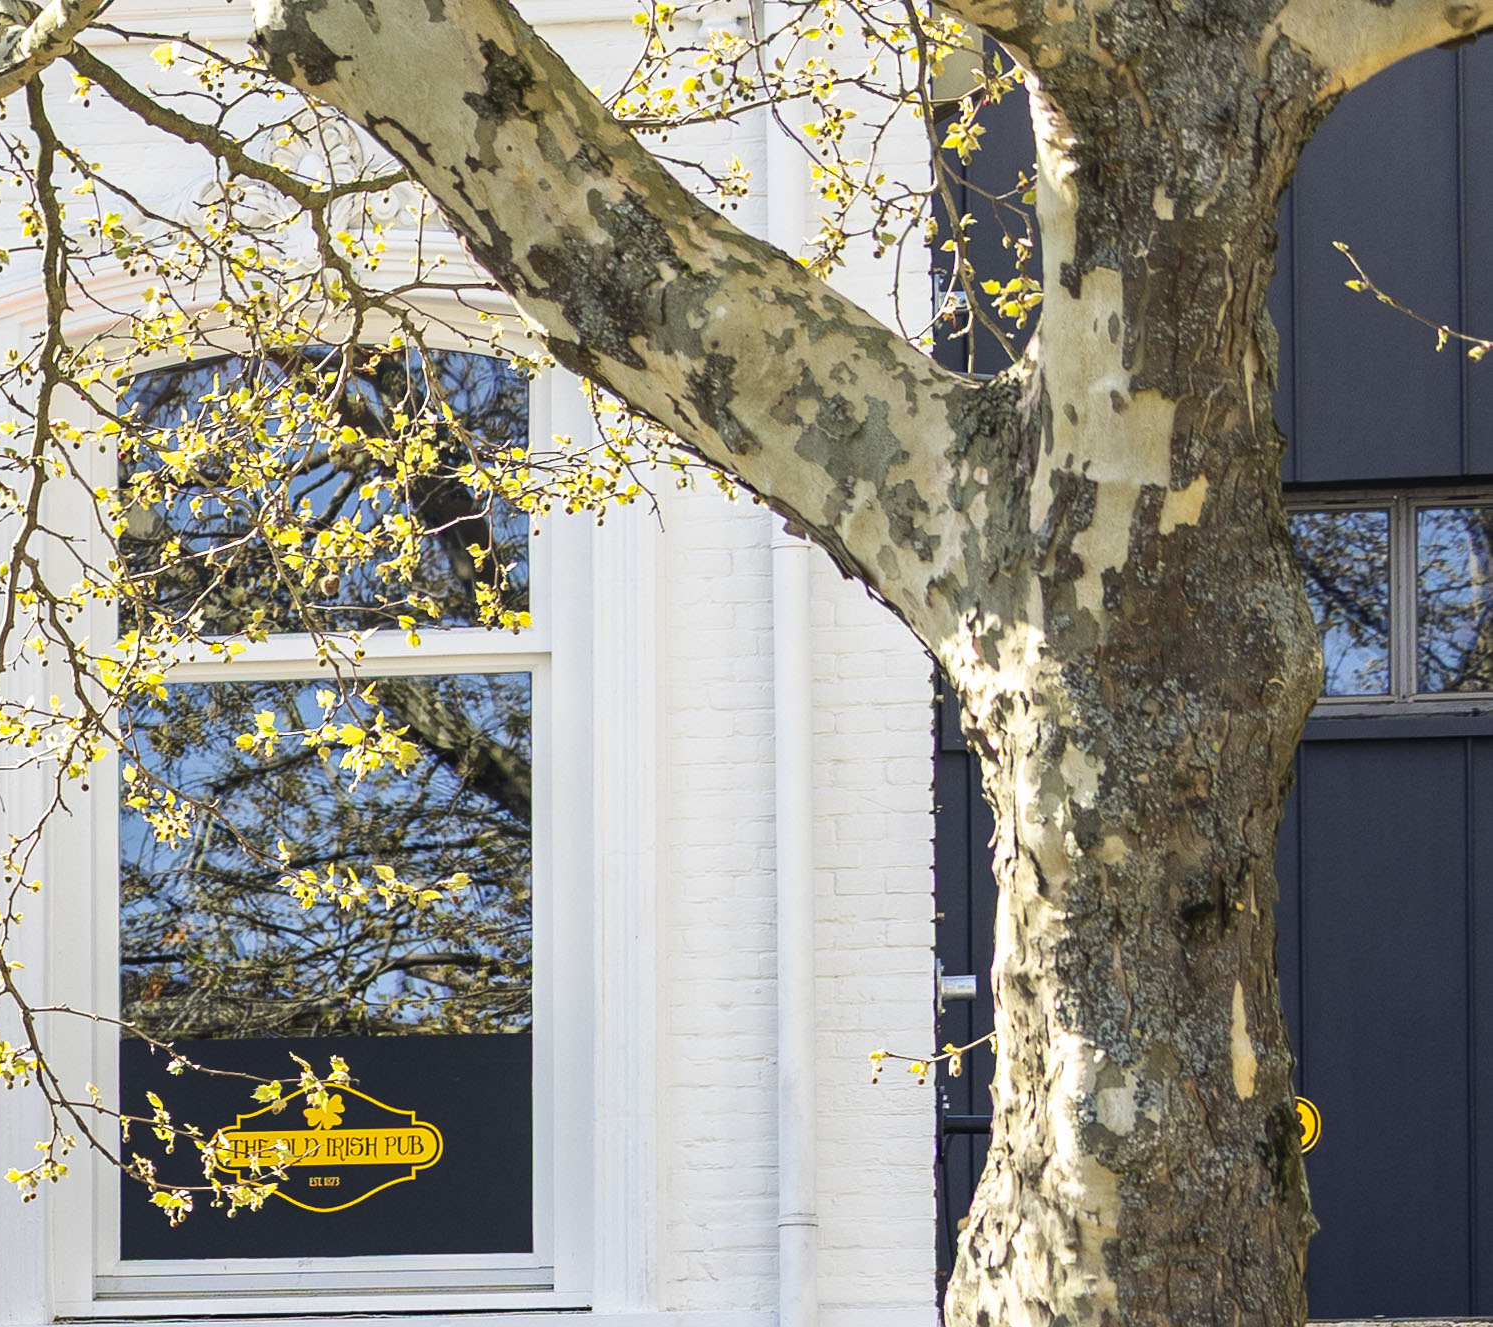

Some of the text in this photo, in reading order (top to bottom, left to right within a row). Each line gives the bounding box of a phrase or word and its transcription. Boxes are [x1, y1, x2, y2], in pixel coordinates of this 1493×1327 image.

[230, 1135, 425, 1162] THE IRISH PUB
